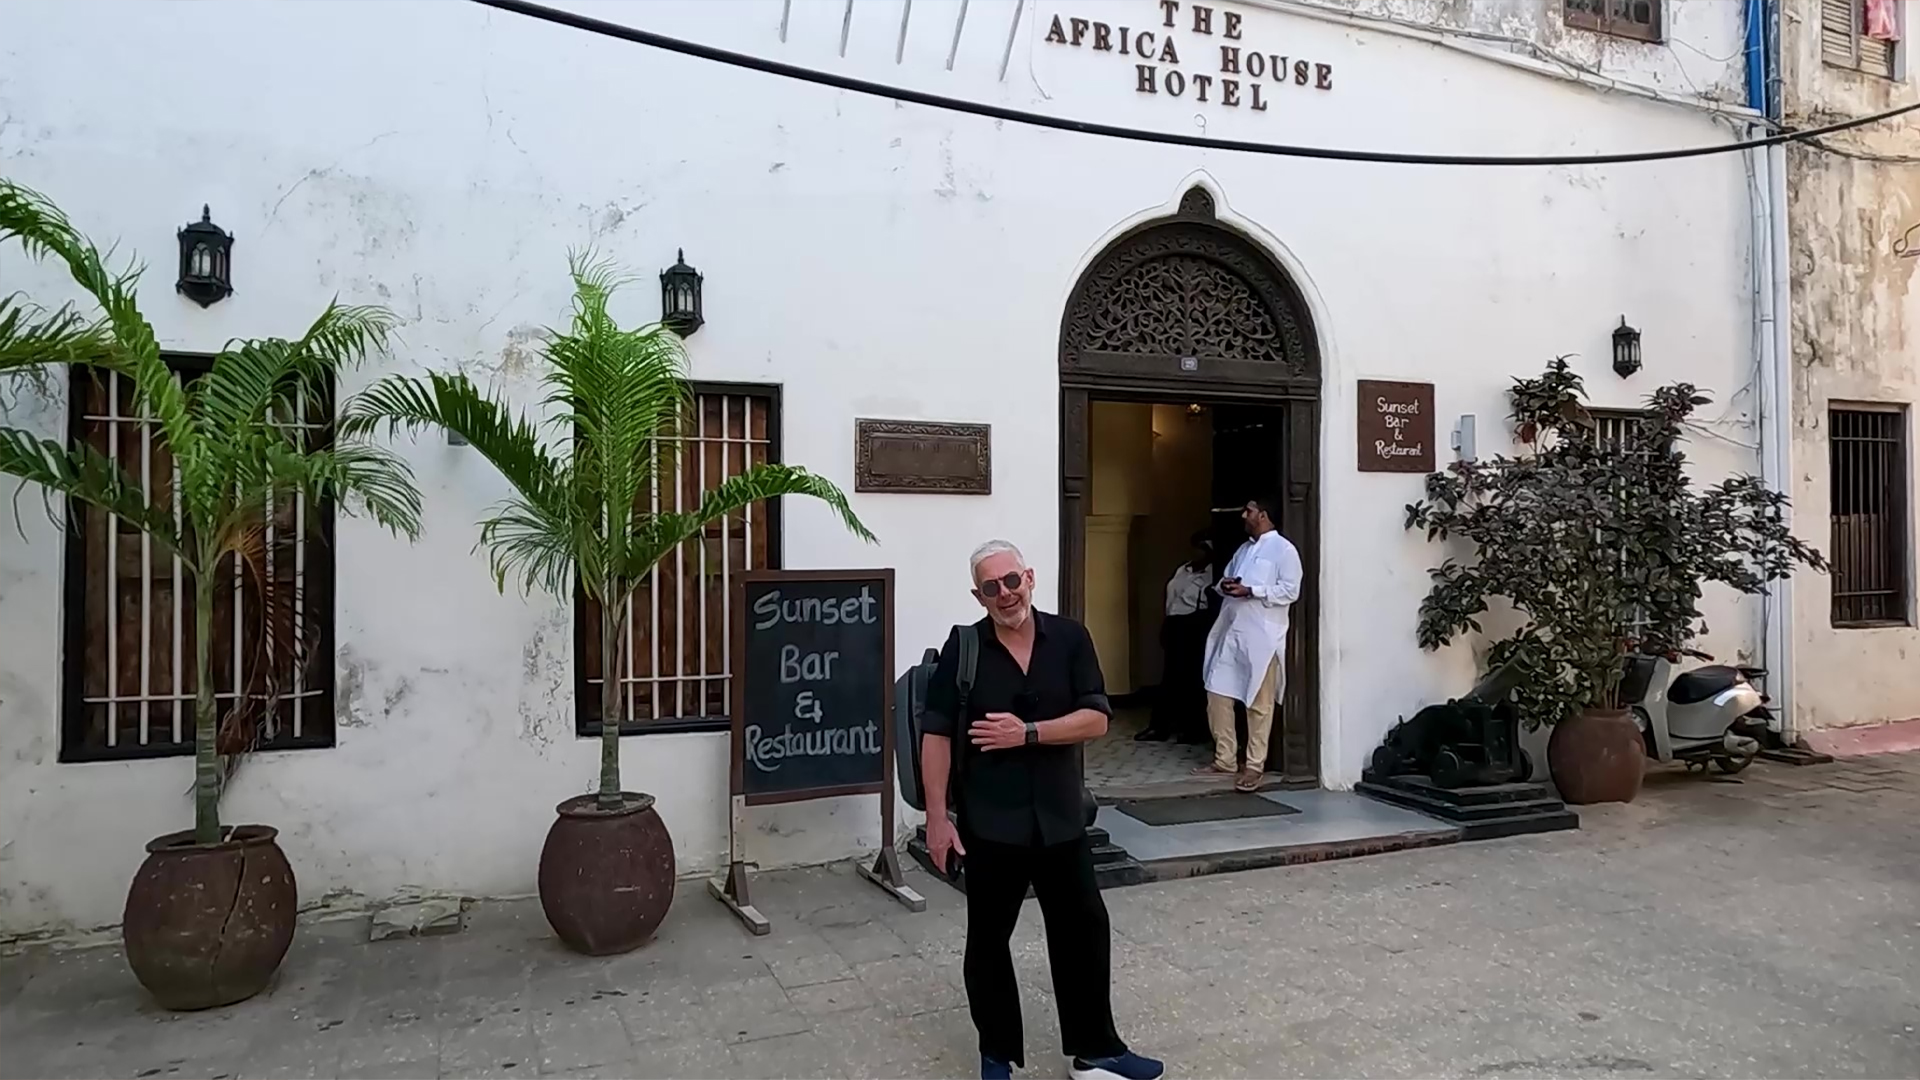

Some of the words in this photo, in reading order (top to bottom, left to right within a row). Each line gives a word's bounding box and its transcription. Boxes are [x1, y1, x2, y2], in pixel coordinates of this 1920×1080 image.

[1160, 1, 1242, 39] THE
[1045, 14, 1180, 64] AFRICA
[1220, 45, 1332, 90] HOUSE
[1136, 64, 1267, 111] HOTEL
[1377, 396, 1420, 414] Sunset
[1384, 414, 1409, 428] Bar
[1394, 428, 1403, 440] &
[753, 585, 876, 630] Sunset
[780, 644, 839, 684] Bar
[794, 691, 823, 723] &
[745, 720, 881, 772] Restaurant
